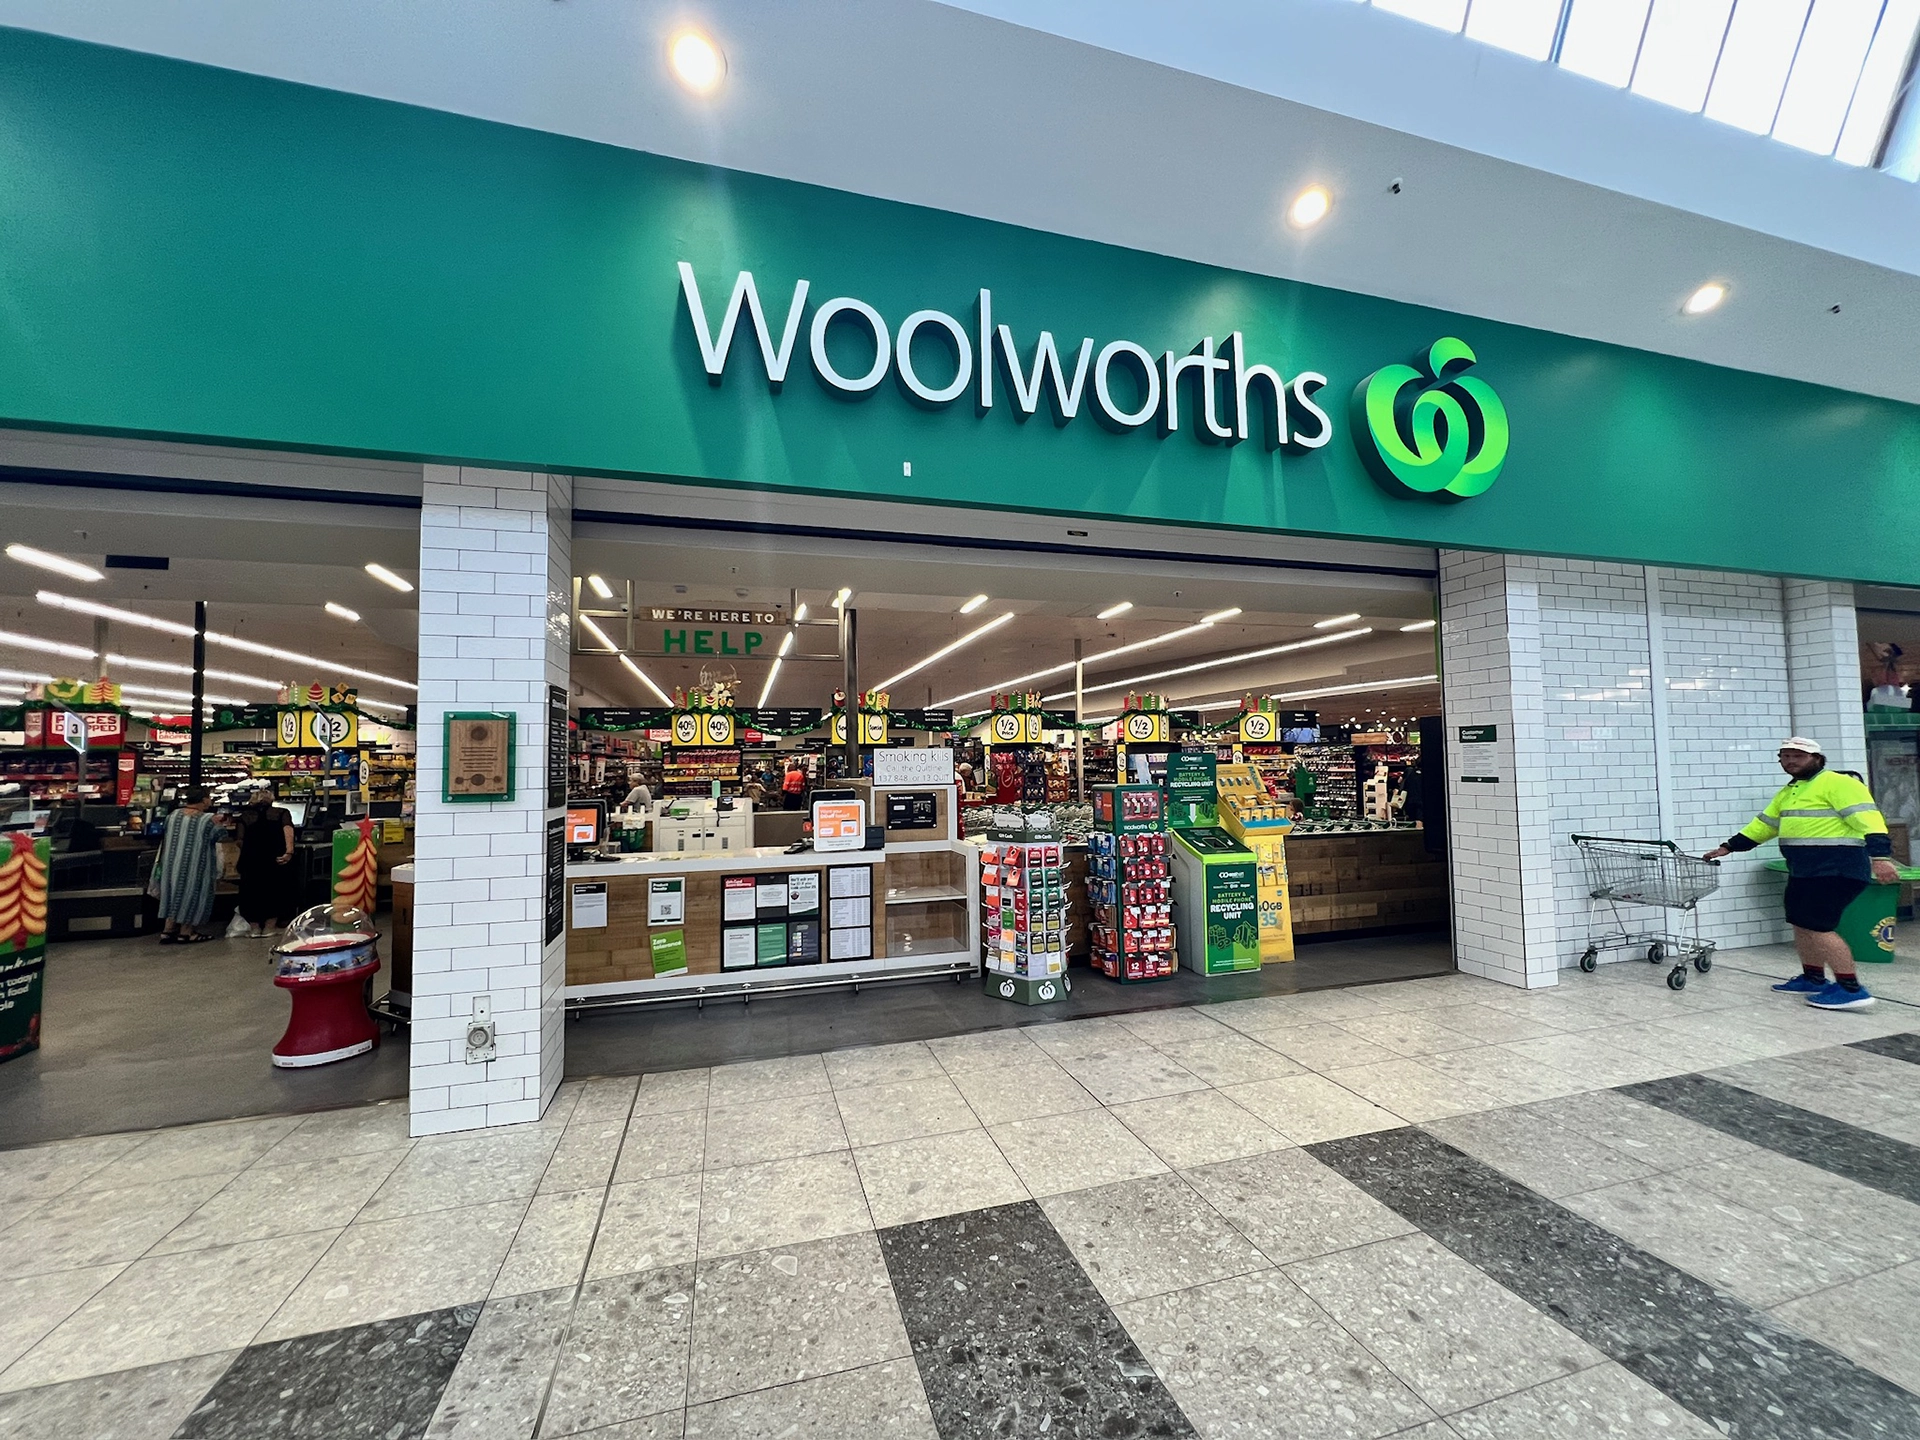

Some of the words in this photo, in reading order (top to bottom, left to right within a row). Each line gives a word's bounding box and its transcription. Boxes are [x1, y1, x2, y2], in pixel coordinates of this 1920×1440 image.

[677, 261, 1332, 449] Woolworths
[652, 609, 703, 621] WE'RE
[709, 611, 750, 622] HERE
[755, 613, 775, 623] TO
[663, 629, 763, 655] HELP
[72, 724, 79, 734] 3
[322, 722, 326, 734] 4
[679, 720, 694, 731] 40%
[710, 720, 728, 731] 40%
[1001, 719, 1014, 731] 1/2
[1134, 720, 1148, 730] 1/2
[1251, 720, 1264, 731] 1/2
[878, 750, 926, 764] Smoking
[931, 750, 949, 762] kills
[886, 764, 900, 772] Call
[902, 764, 914, 772] the
[915, 764, 942, 773] Quitline
[1210, 902, 1254, 912] RECYCLING
[1260, 901, 1282, 911] 0GB
[654, 941, 682, 950] tolerance
[8, 984, 29, 997] food
